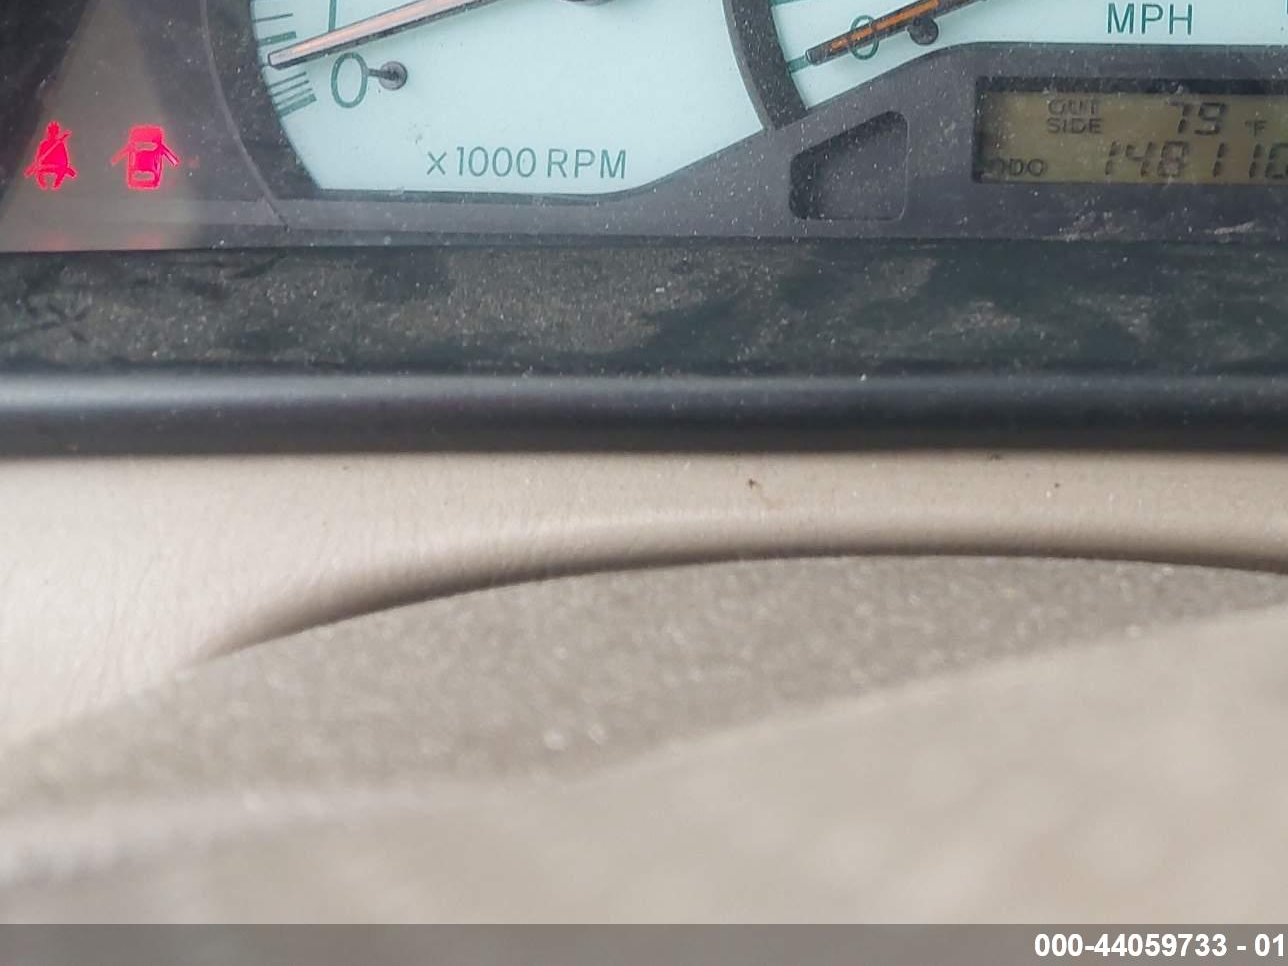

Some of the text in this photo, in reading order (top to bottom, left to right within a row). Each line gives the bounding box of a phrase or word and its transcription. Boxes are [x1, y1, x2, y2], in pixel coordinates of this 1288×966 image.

[1107, 3, 1193, 34] MPH
[331, 52, 367, 108] 0
[1048, 99, 1098, 117] OUT
[1167, 102, 1226, 135] 79
[1047, 118, 1104, 134] SIDE
[547, 149, 627, 179] RPM
